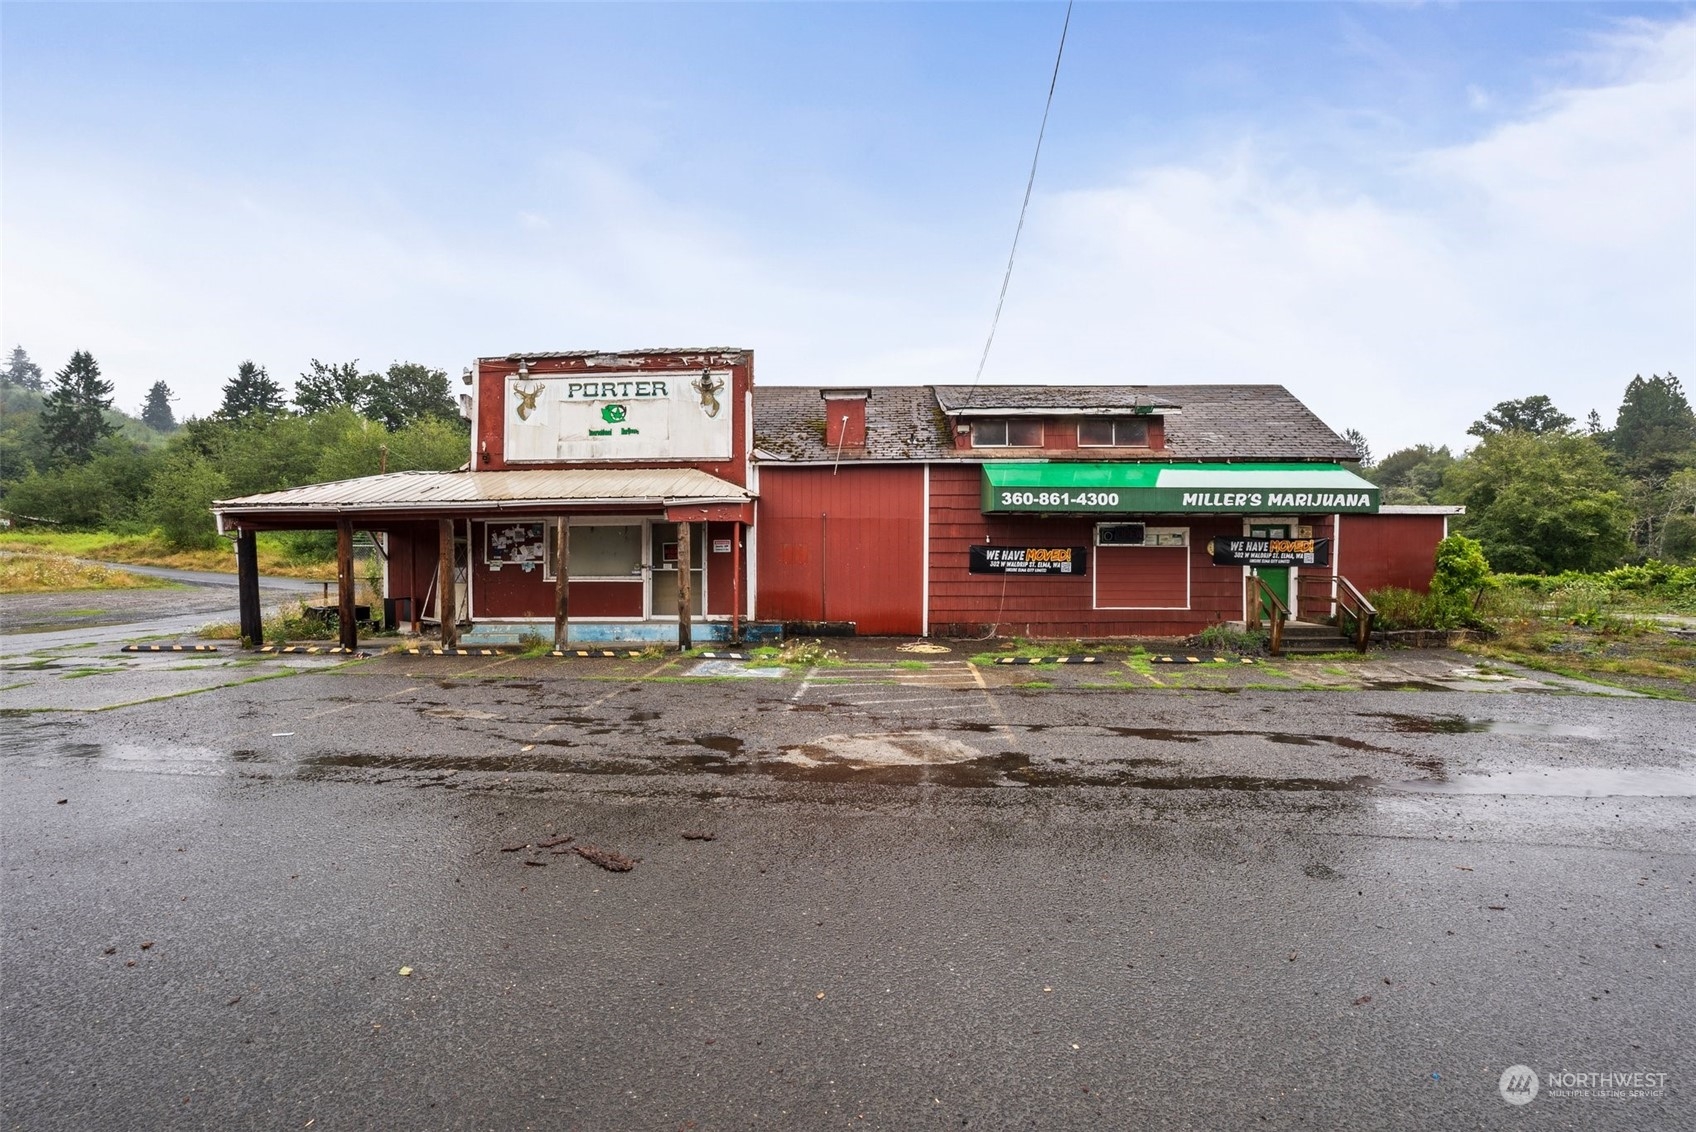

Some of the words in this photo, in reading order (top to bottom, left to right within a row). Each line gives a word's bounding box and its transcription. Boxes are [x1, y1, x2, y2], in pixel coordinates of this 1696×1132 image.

[568, 381, 668, 398] PORTER
[1001, 492, 1119, 506] 360-861-4300
[1182, 492, 1262, 507] MILLER'S
[1267, 492, 1371, 507] MARIJUANA
[1230, 541, 1244, 551] WE
[1246, 541, 1268, 551] HAVE
[1269, 540, 1314, 553] MOVED!
[986, 550, 1000, 560] WE
[1001, 550, 1025, 560] HAVE
[1025, 548, 1072, 561] MOVED!
